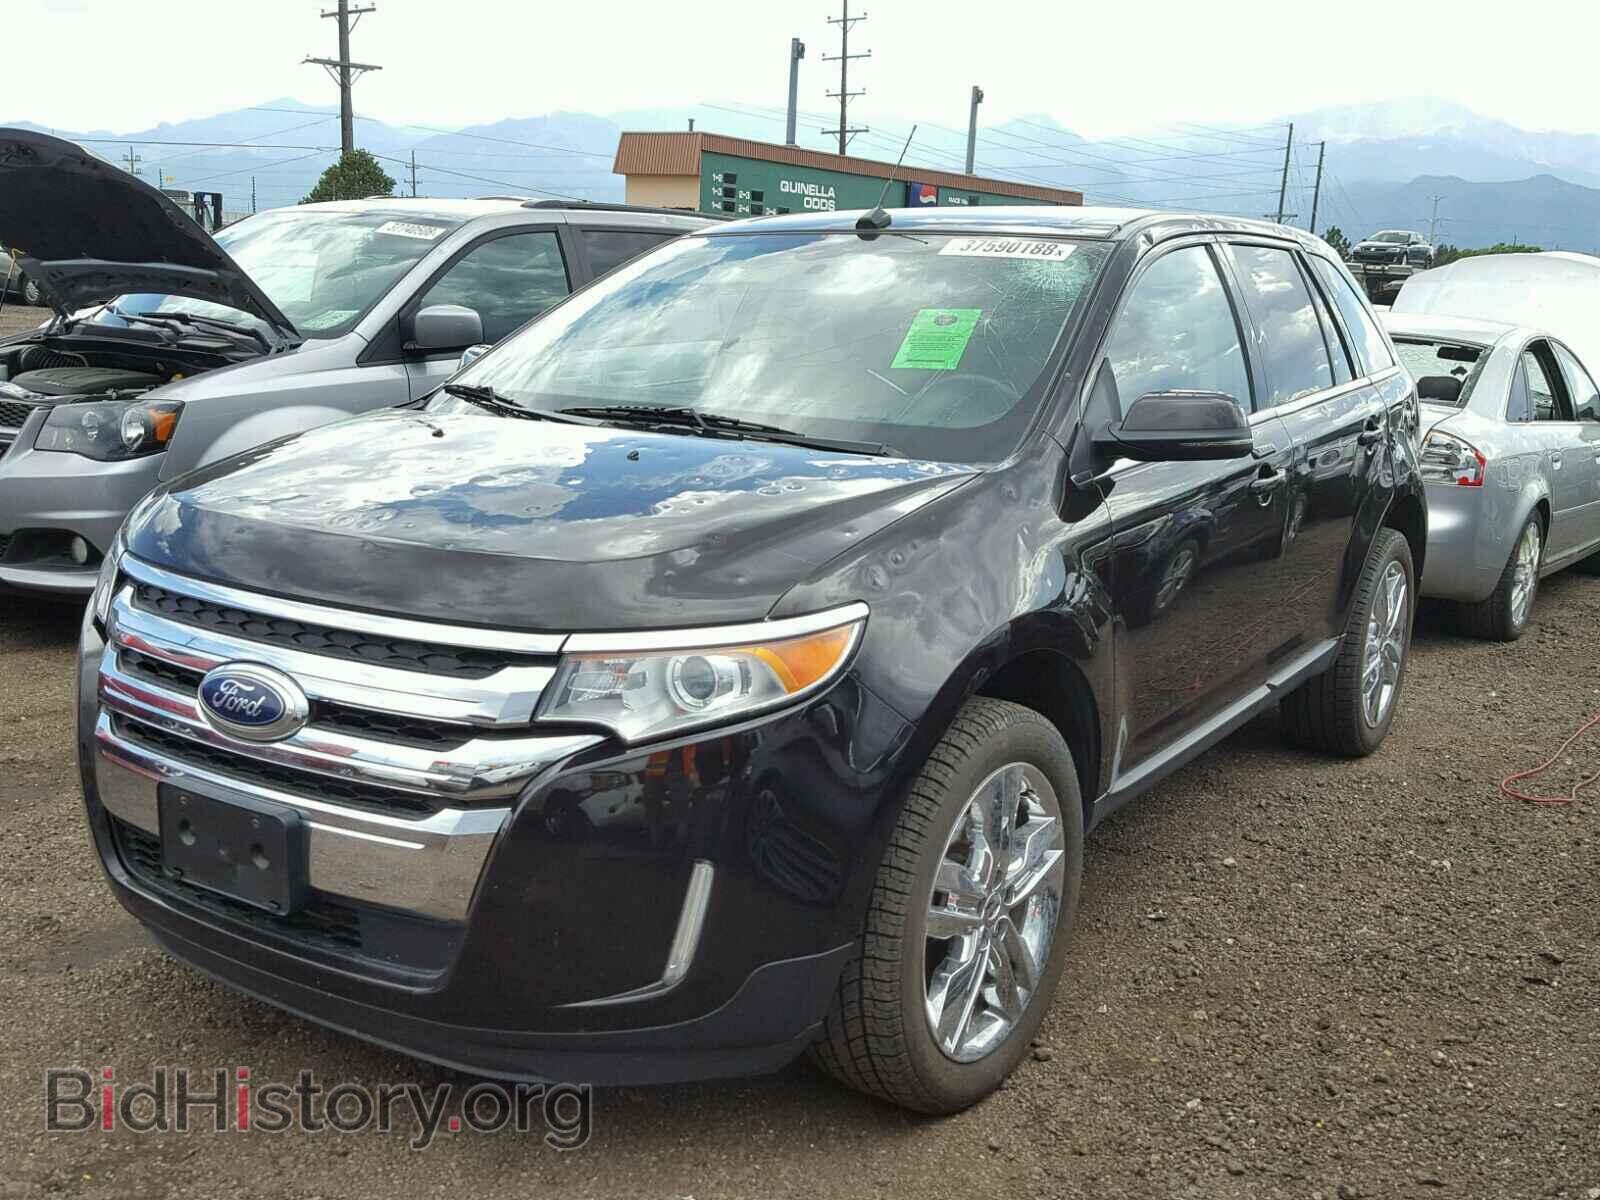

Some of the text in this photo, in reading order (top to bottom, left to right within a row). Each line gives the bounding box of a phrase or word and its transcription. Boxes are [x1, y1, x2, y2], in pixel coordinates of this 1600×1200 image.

[780, 180, 836, 198] QUINELLA
[803, 197, 836, 212] ODDS
[212, 679, 266, 717] Ford
